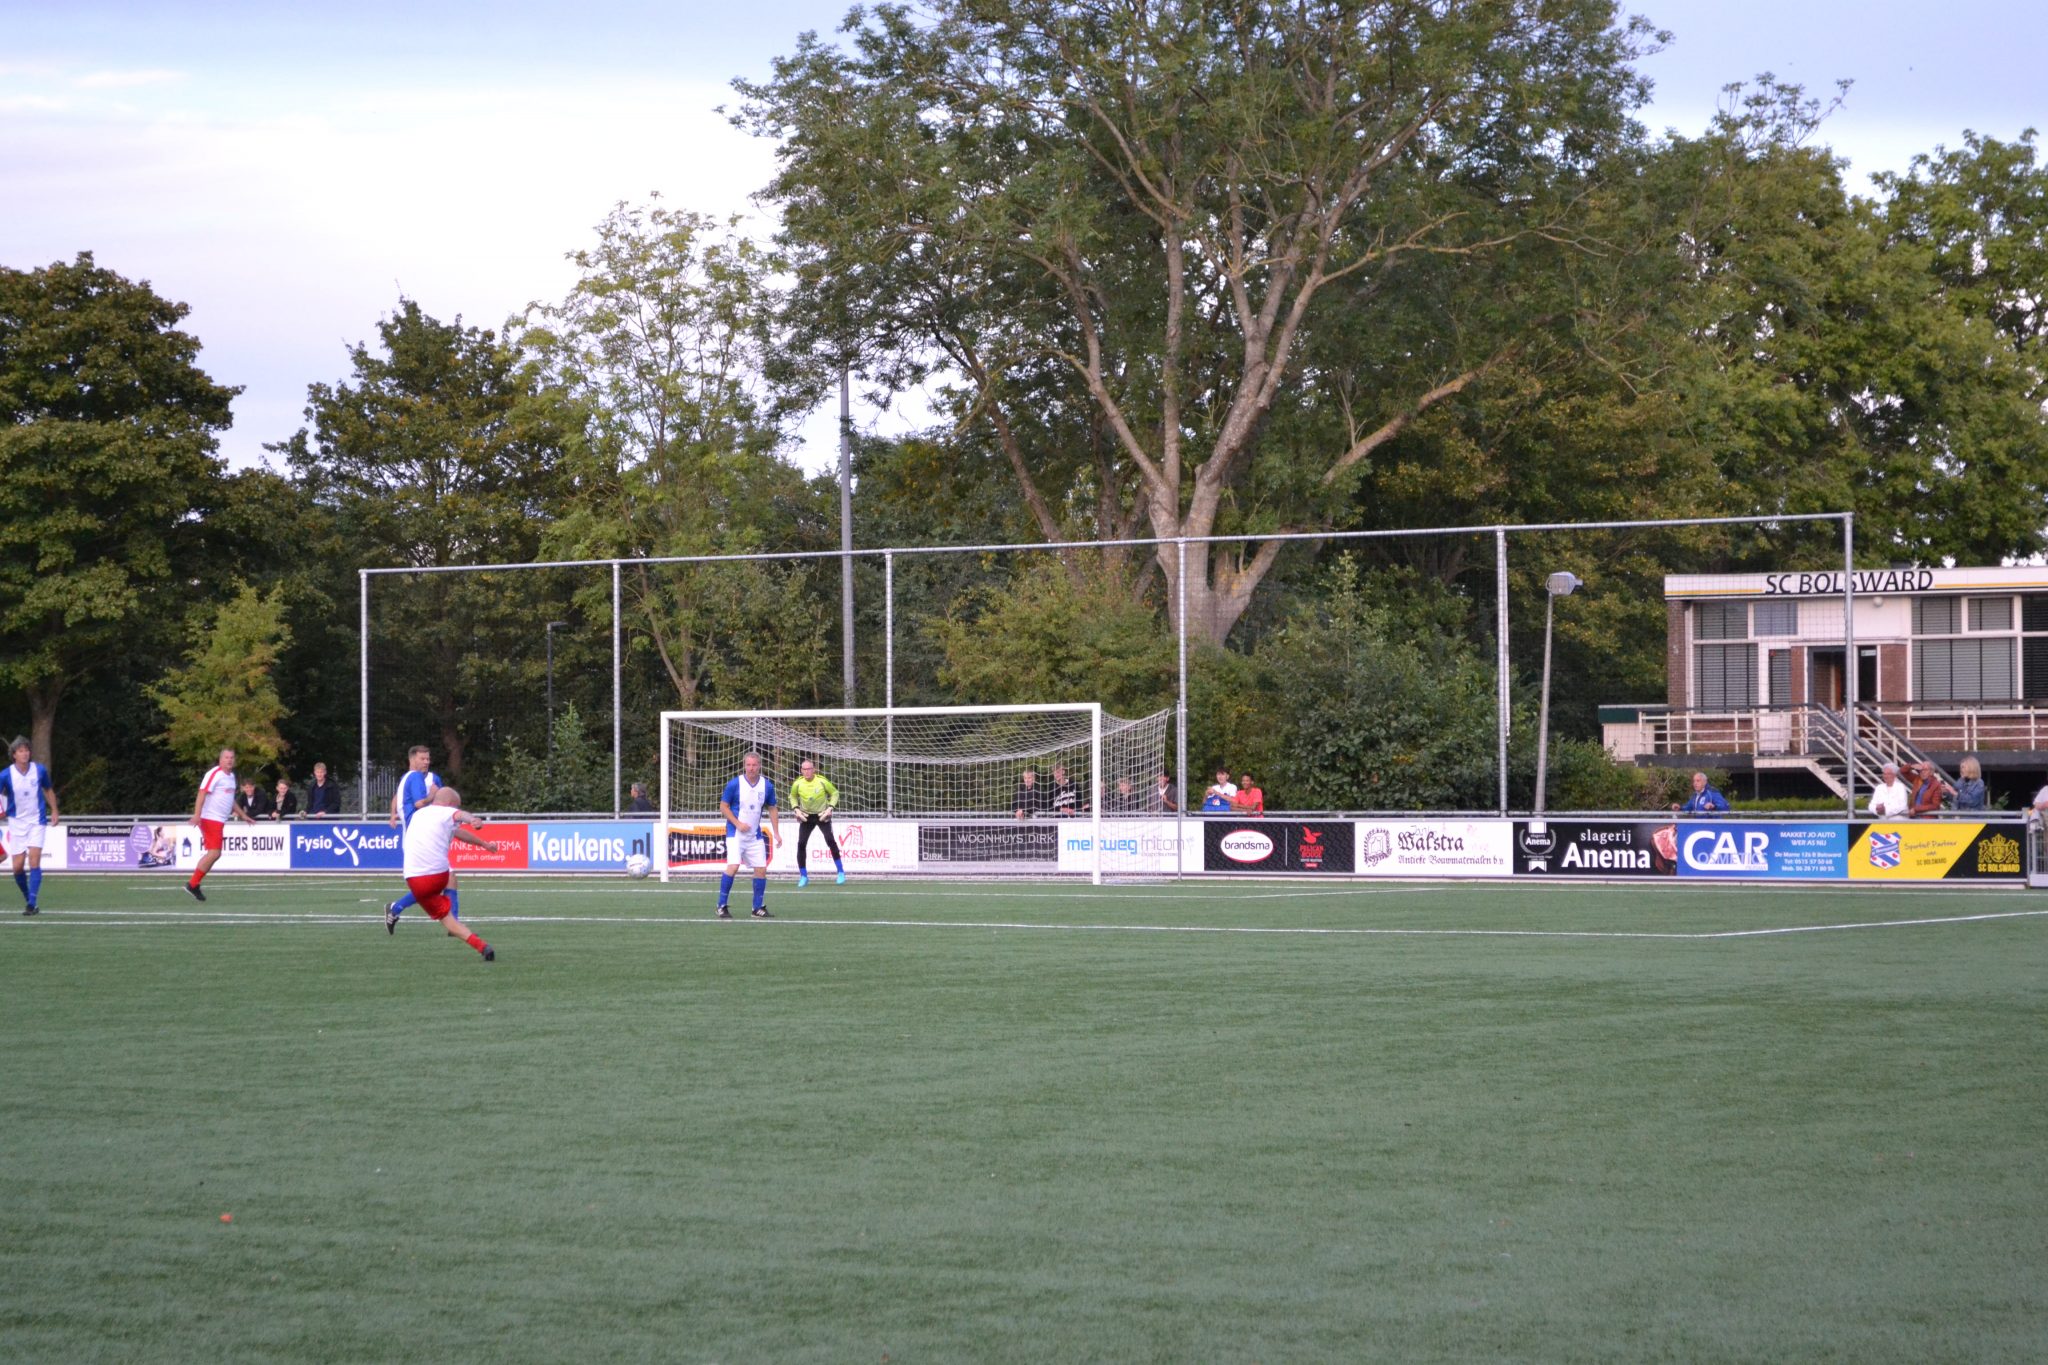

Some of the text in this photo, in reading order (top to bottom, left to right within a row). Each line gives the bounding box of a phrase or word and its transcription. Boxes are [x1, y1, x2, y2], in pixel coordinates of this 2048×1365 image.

[1765, 574, 1792, 594] SC
[251, 836, 285, 851] BOUW
[296, 835, 399, 852] Fysio Actief
[958, 834, 1024, 844] WOONHUYS
[1028, 834, 1054, 844] DIRK
[1525, 837, 1551, 845] Anema
[1580, 828, 1631, 845] slagerij
[84, 840, 126, 852] ANYTIME
[532, 831, 650, 862] Keukens.nl
[1067, 835, 1138, 855] melweg
[1224, 840, 1270, 850] brandsma
[1684, 830, 1770, 870] CAR
[85, 852, 126, 862] FITNESS
[922, 852, 944, 860] DIRK
[1561, 842, 1651, 868] Anema
[1978, 863, 2020, 873] SC BOLSWARD
